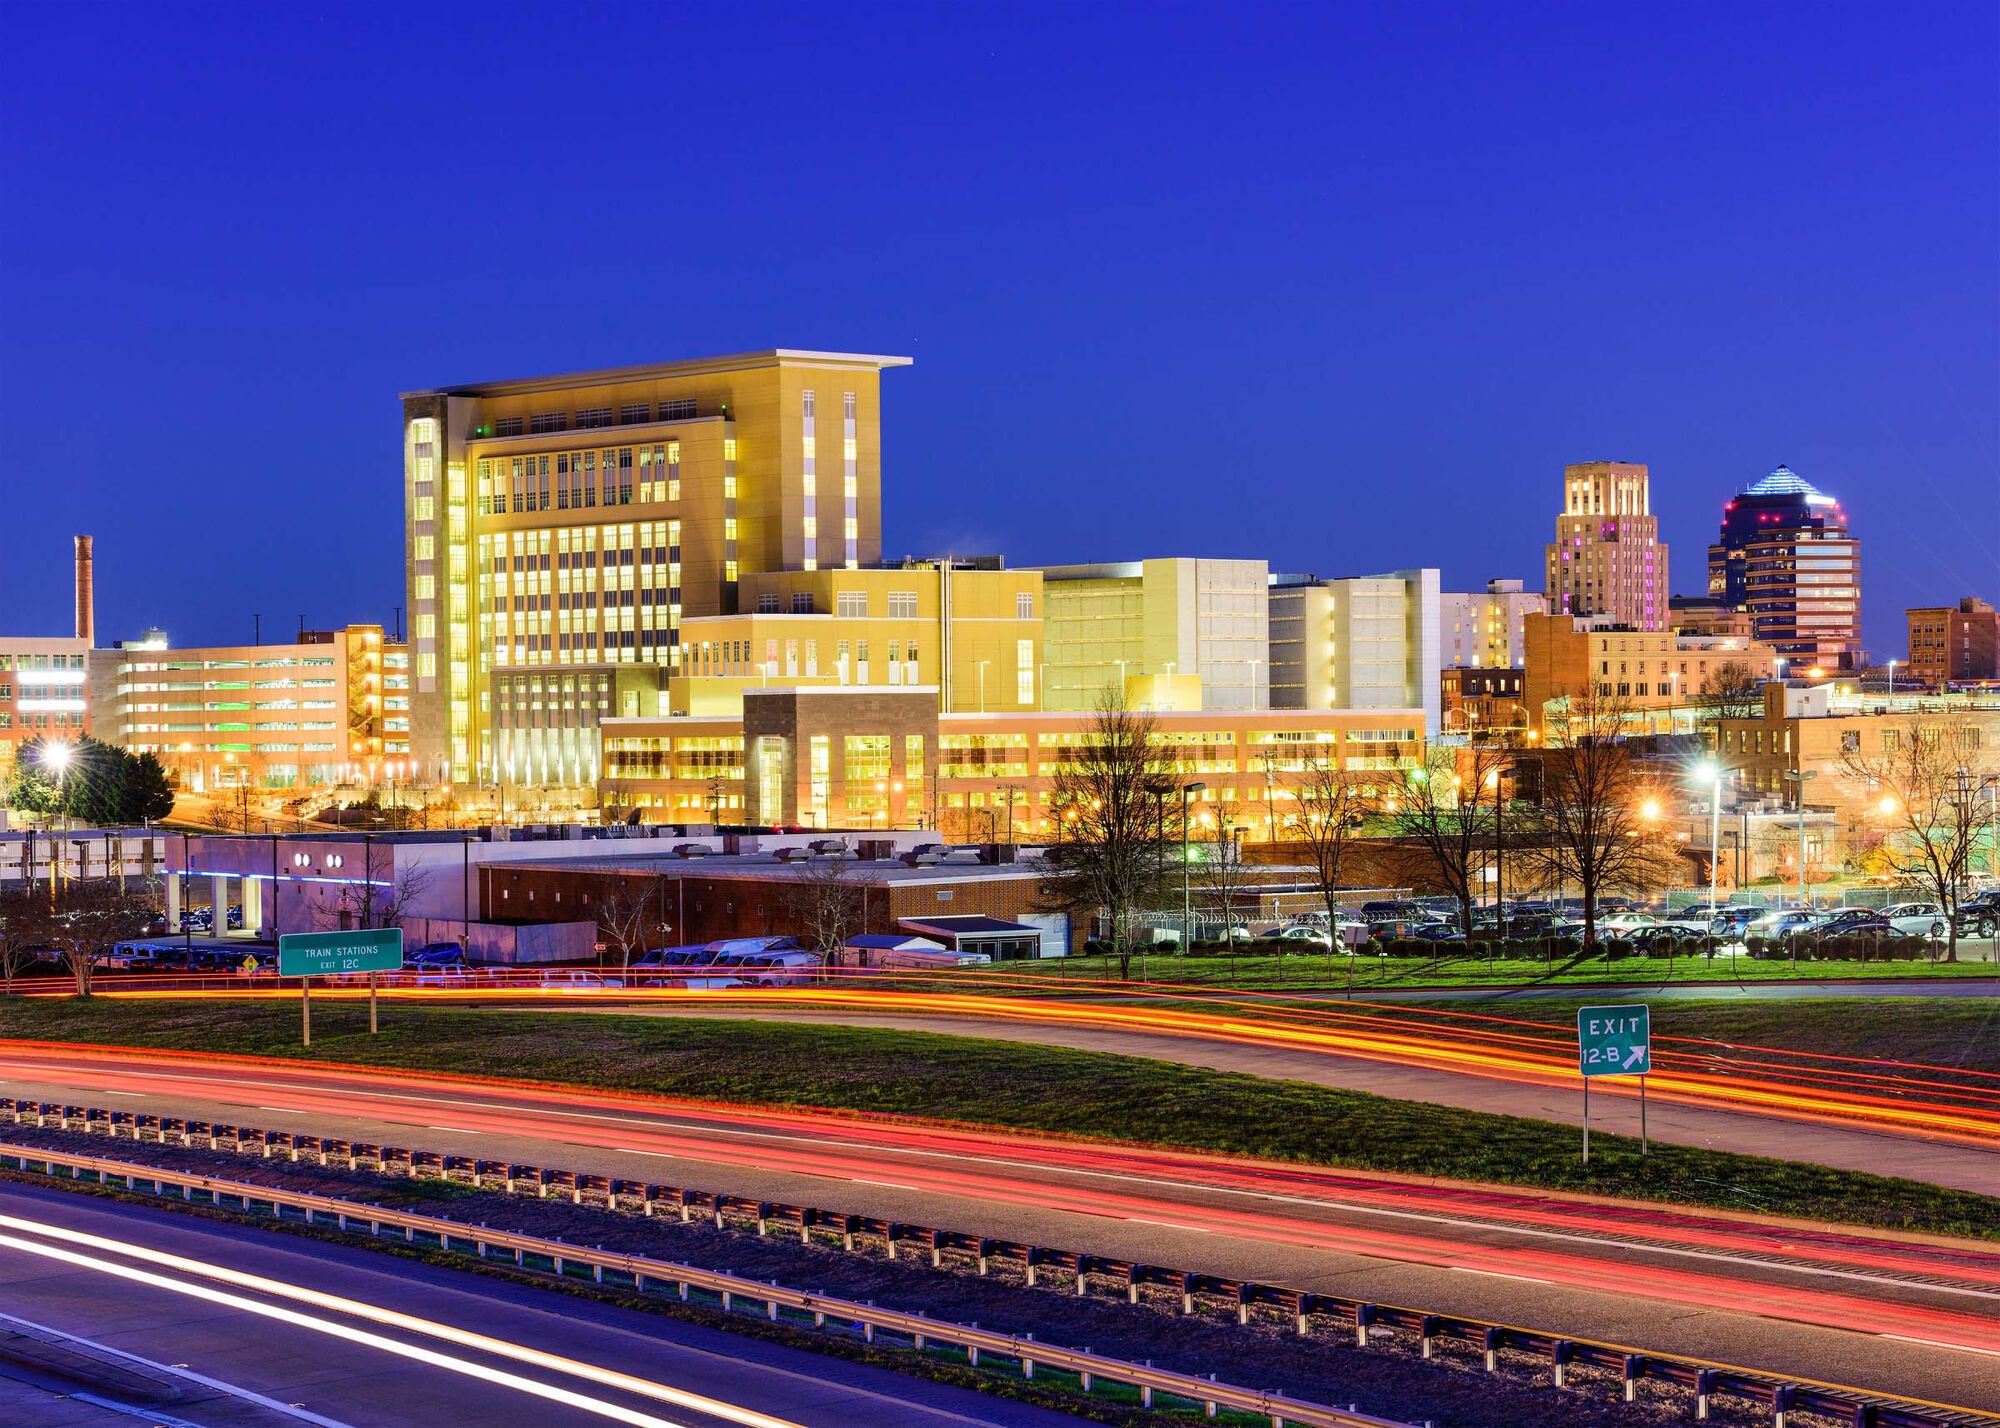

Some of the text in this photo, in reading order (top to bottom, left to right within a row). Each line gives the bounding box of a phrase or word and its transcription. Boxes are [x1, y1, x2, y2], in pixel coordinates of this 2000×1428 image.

[305, 945, 378, 958] TRAIN STATIONS
[320, 958, 359, 969] EXIT 12C
[1589, 1017, 1639, 1036] EXIT
[1582, 1046, 1620, 1064] 12-B
